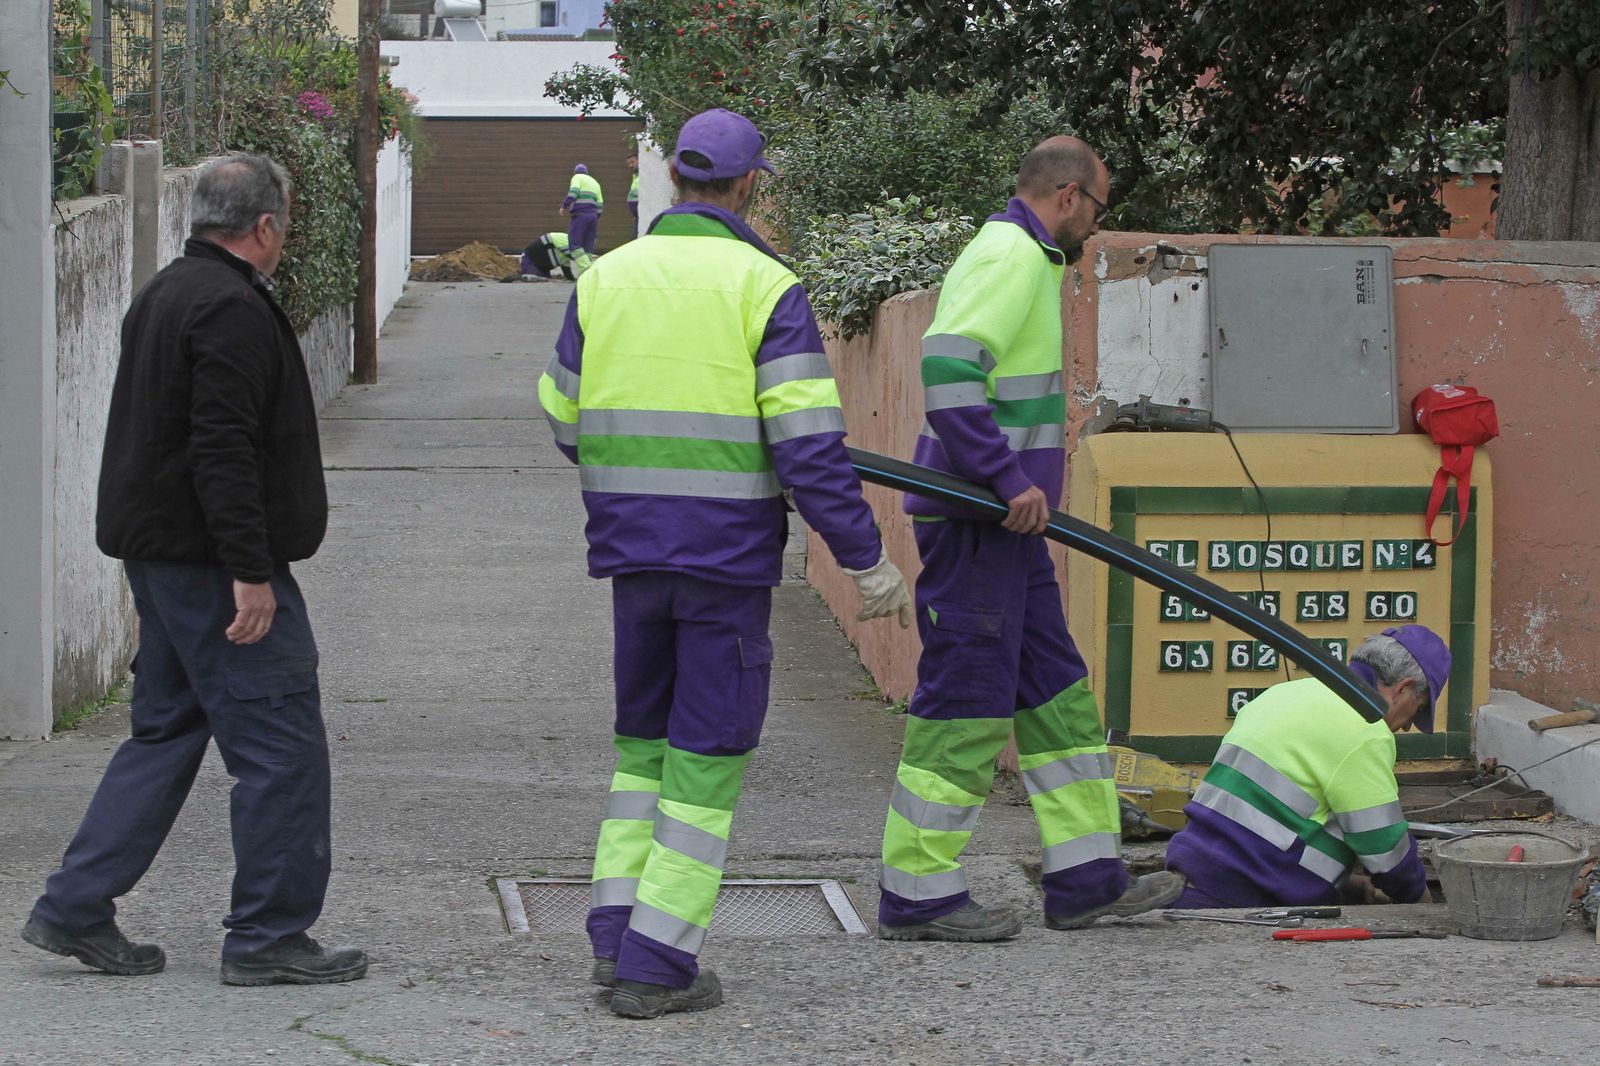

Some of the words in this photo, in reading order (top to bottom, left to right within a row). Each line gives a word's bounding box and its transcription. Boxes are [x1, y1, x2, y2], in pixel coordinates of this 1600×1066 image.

[1356, 267, 1365, 304] BAN
[1211, 543, 1361, 567] BOSQUE
[1302, 594, 1345, 617] 58
[1370, 594, 1414, 617] 60
[1231, 644, 1276, 668] 62
[1118, 755, 1133, 782] BOSCH
